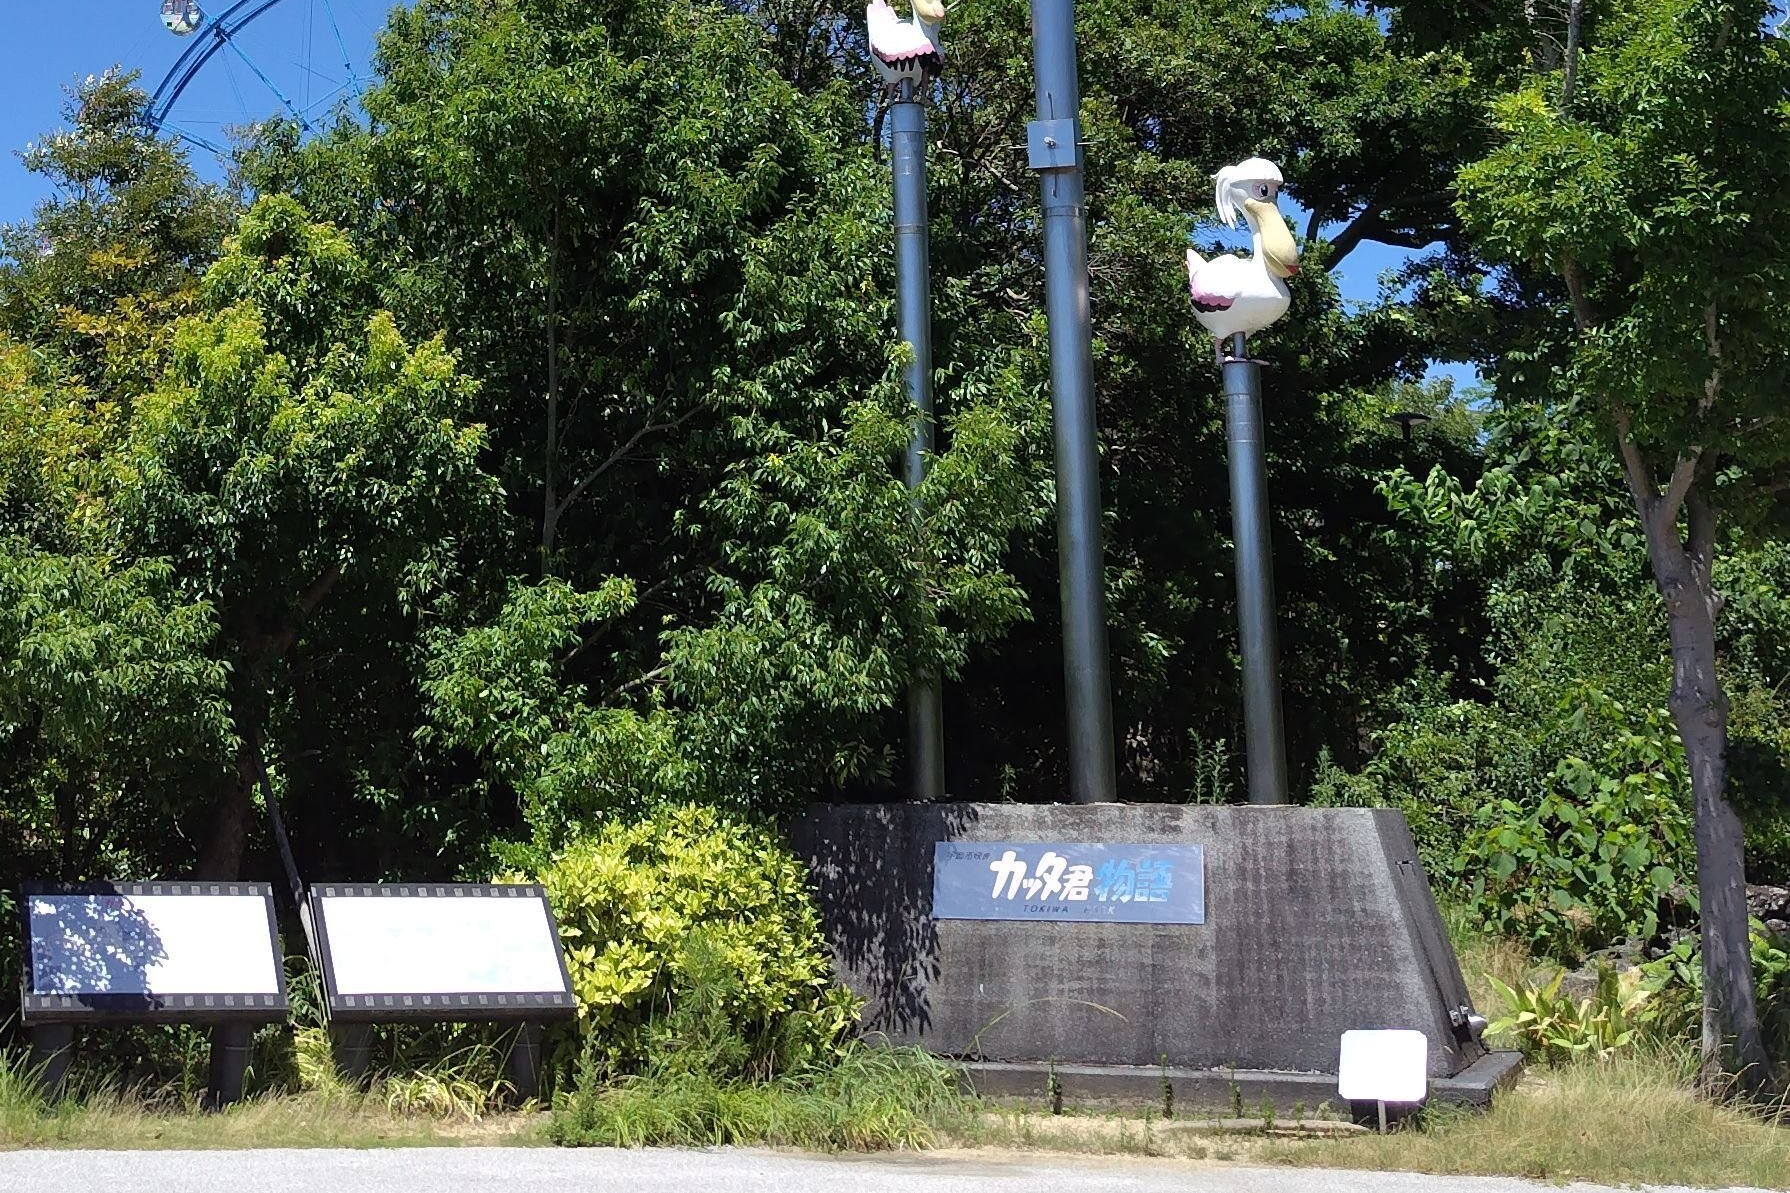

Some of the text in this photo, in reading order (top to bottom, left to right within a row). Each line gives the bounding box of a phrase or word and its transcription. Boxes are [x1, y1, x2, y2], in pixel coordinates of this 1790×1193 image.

[989, 850, 1174, 903] カッタ君物語
[1023, 904, 1069, 913] TOKIWA
